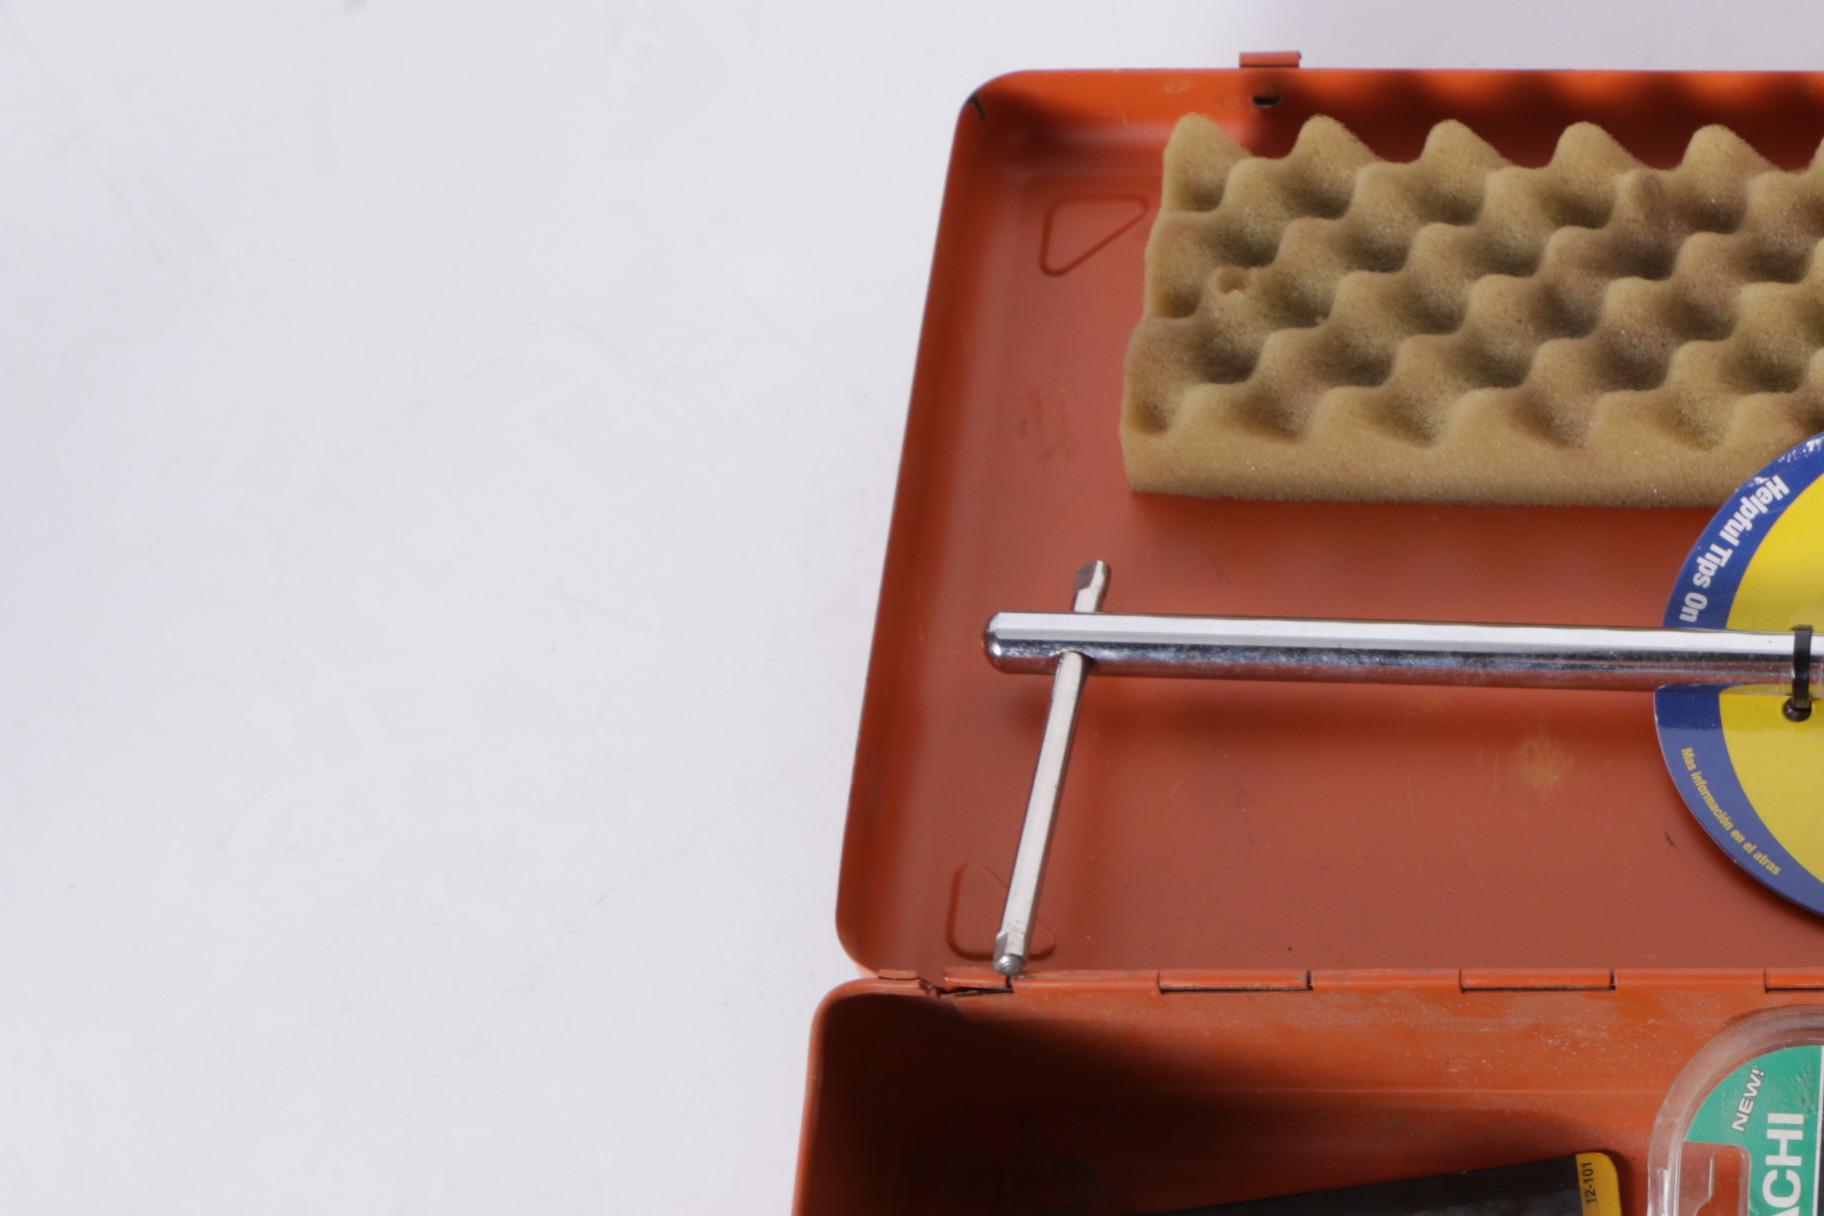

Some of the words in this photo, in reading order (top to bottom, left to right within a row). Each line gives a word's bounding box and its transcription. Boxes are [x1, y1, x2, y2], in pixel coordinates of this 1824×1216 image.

[1719, 475, 1790, 546] Helpful
[1693, 544, 1733, 588] Tips
[1679, 592, 1708, 623] On
[1730, 829, 1745, 843] en
[1743, 842, 1757, 853] el
[1731, 1068, 1766, 1132] NEW!
[1582, 1162, 1597, 1204] 12-101
